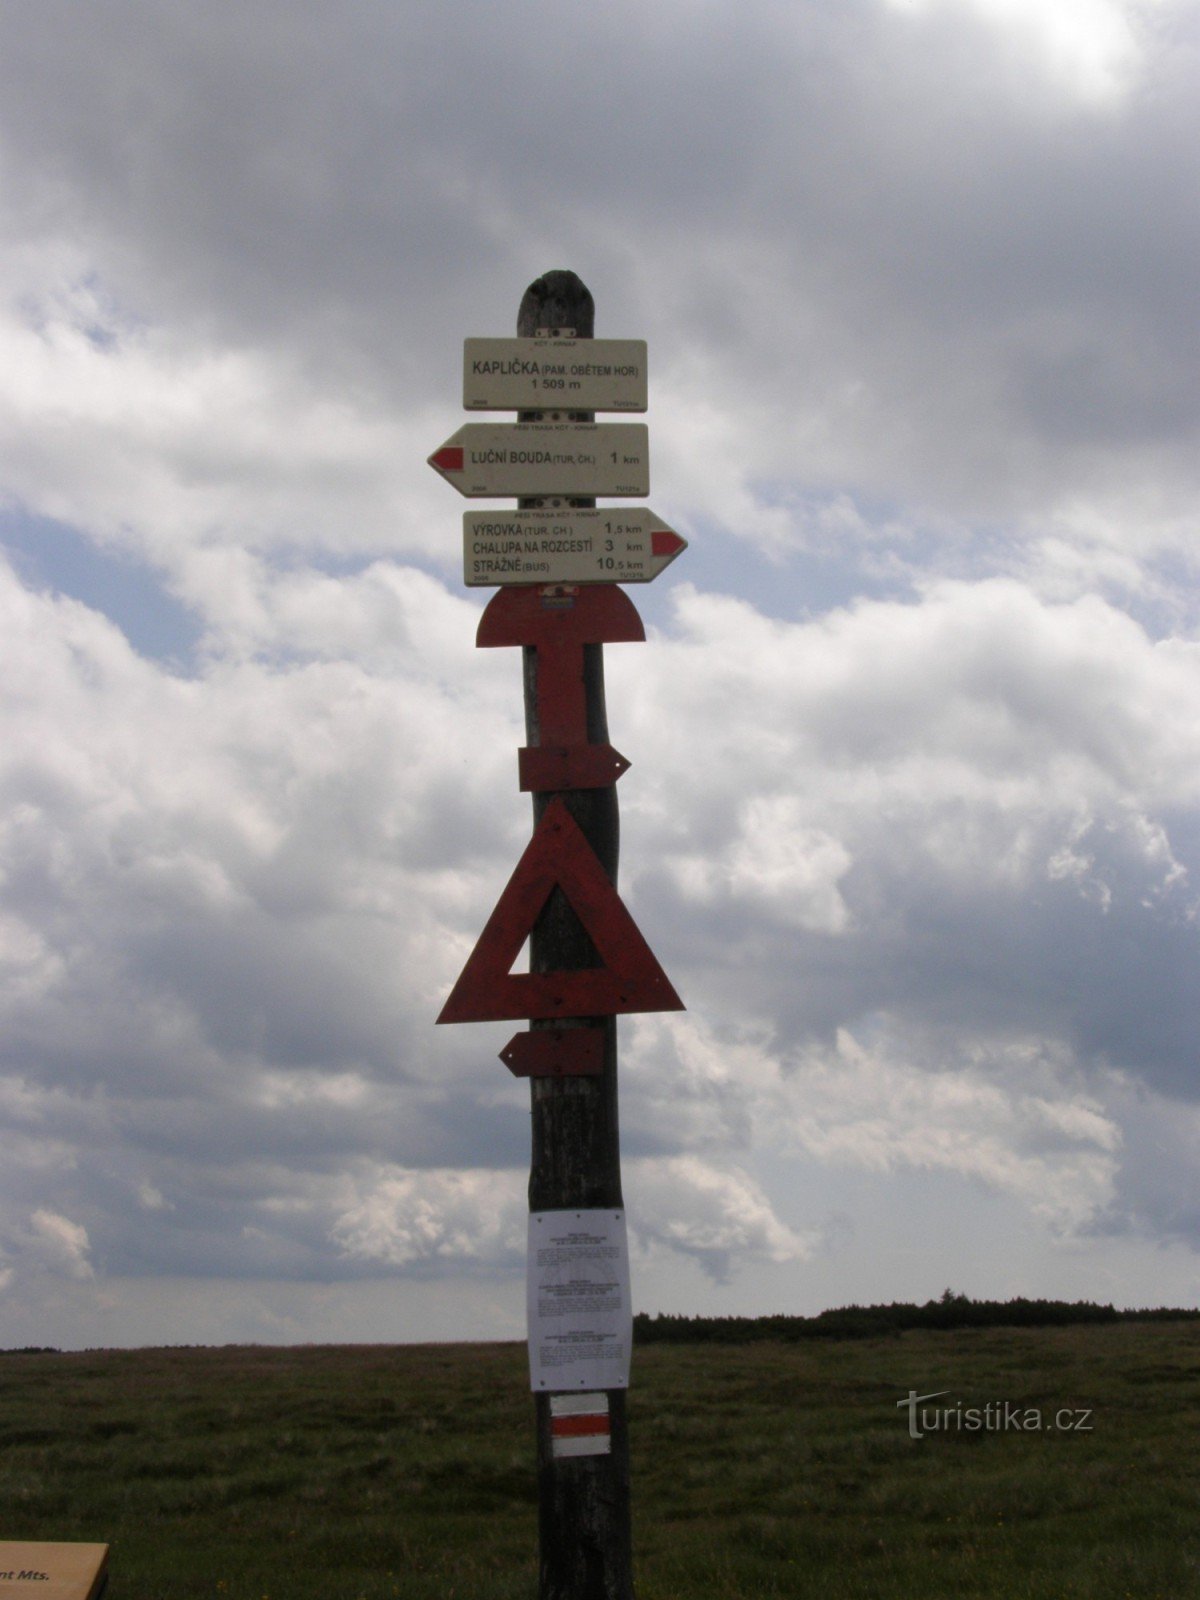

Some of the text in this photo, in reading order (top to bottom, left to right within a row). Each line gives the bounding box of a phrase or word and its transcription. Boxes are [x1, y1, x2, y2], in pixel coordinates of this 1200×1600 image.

[472, 357, 540, 375] KAPLIČKA
[542, 365, 568, 376] (PAM.
[614, 366, 639, 377] HOR)
[532, 380, 581, 389] 1 509 m
[471, 449, 507, 464] LUČNÍ
[510, 452, 552, 464] BOUDA
[610, 452, 618, 464] 1
[624, 456, 640, 464] km
[473, 522, 522, 536] VÝROVKA
[626, 525, 642, 534] km
[473, 537, 642, 554] CHALUPA NA ROZCESTÍ 3 km
[522, 563, 550, 573] (BUS)
[626, 561, 644, 570] km
[17, 1570, 50, 1581] Mts.
